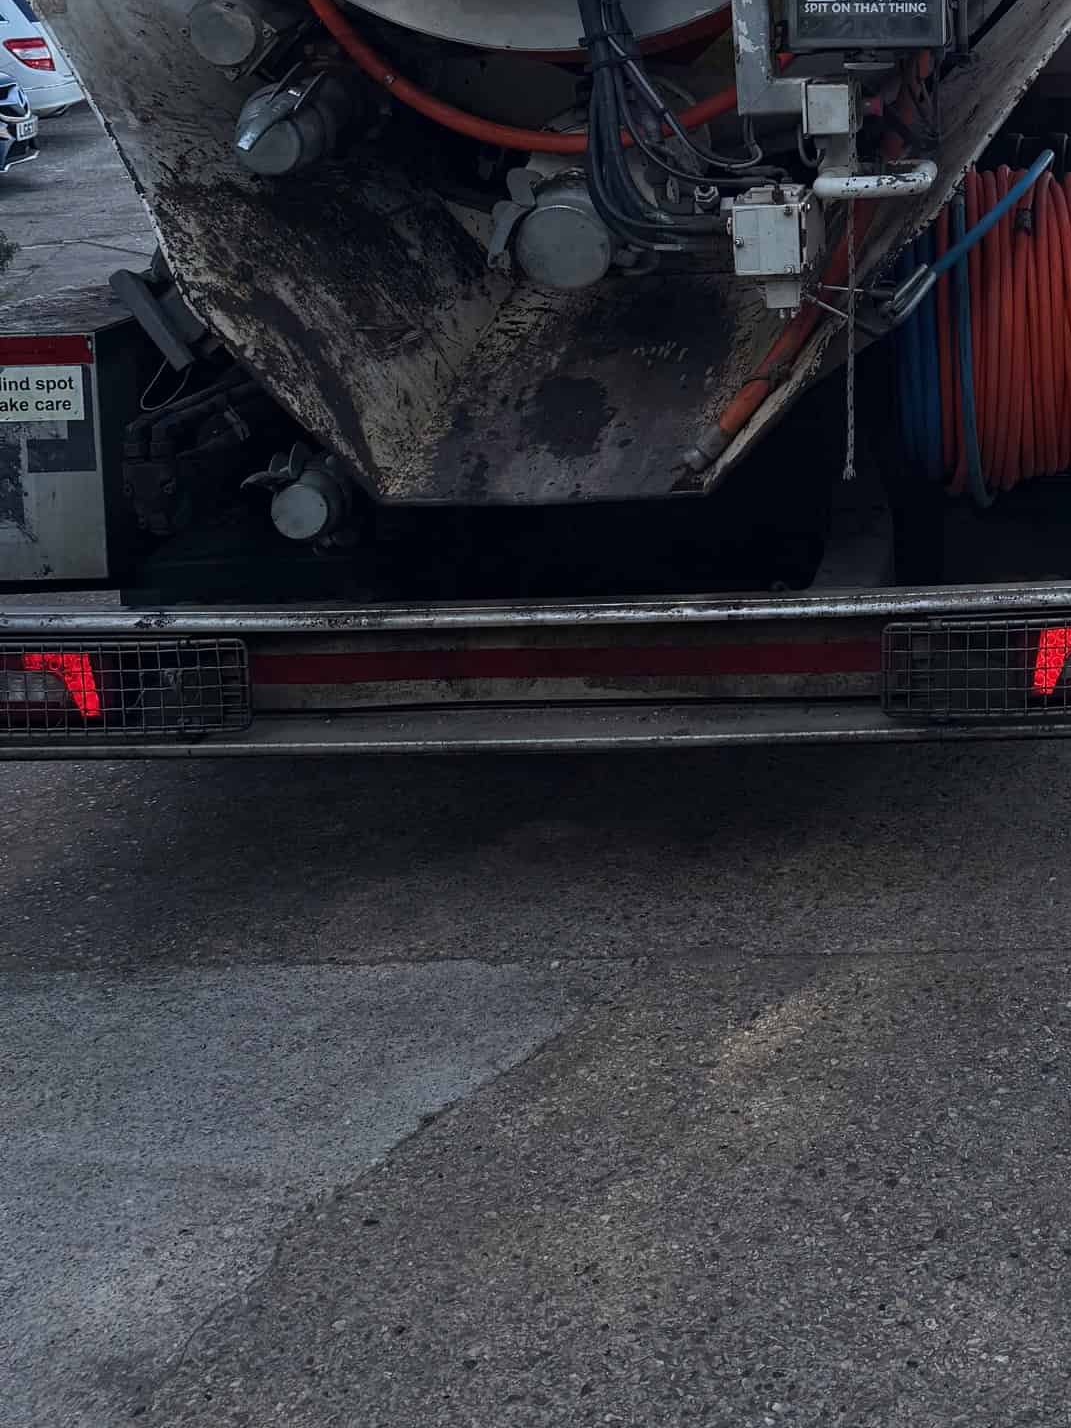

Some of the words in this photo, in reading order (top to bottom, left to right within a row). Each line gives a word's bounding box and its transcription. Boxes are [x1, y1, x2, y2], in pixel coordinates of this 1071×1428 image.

[804, 2, 828, 13] SPIT
[831, 2, 851, 13] ON
[855, 2, 886, 13] THAT
[886, 2, 927, 13] THING
[35, 375, 75, 394] spot
[34, 399, 72, 411] care
